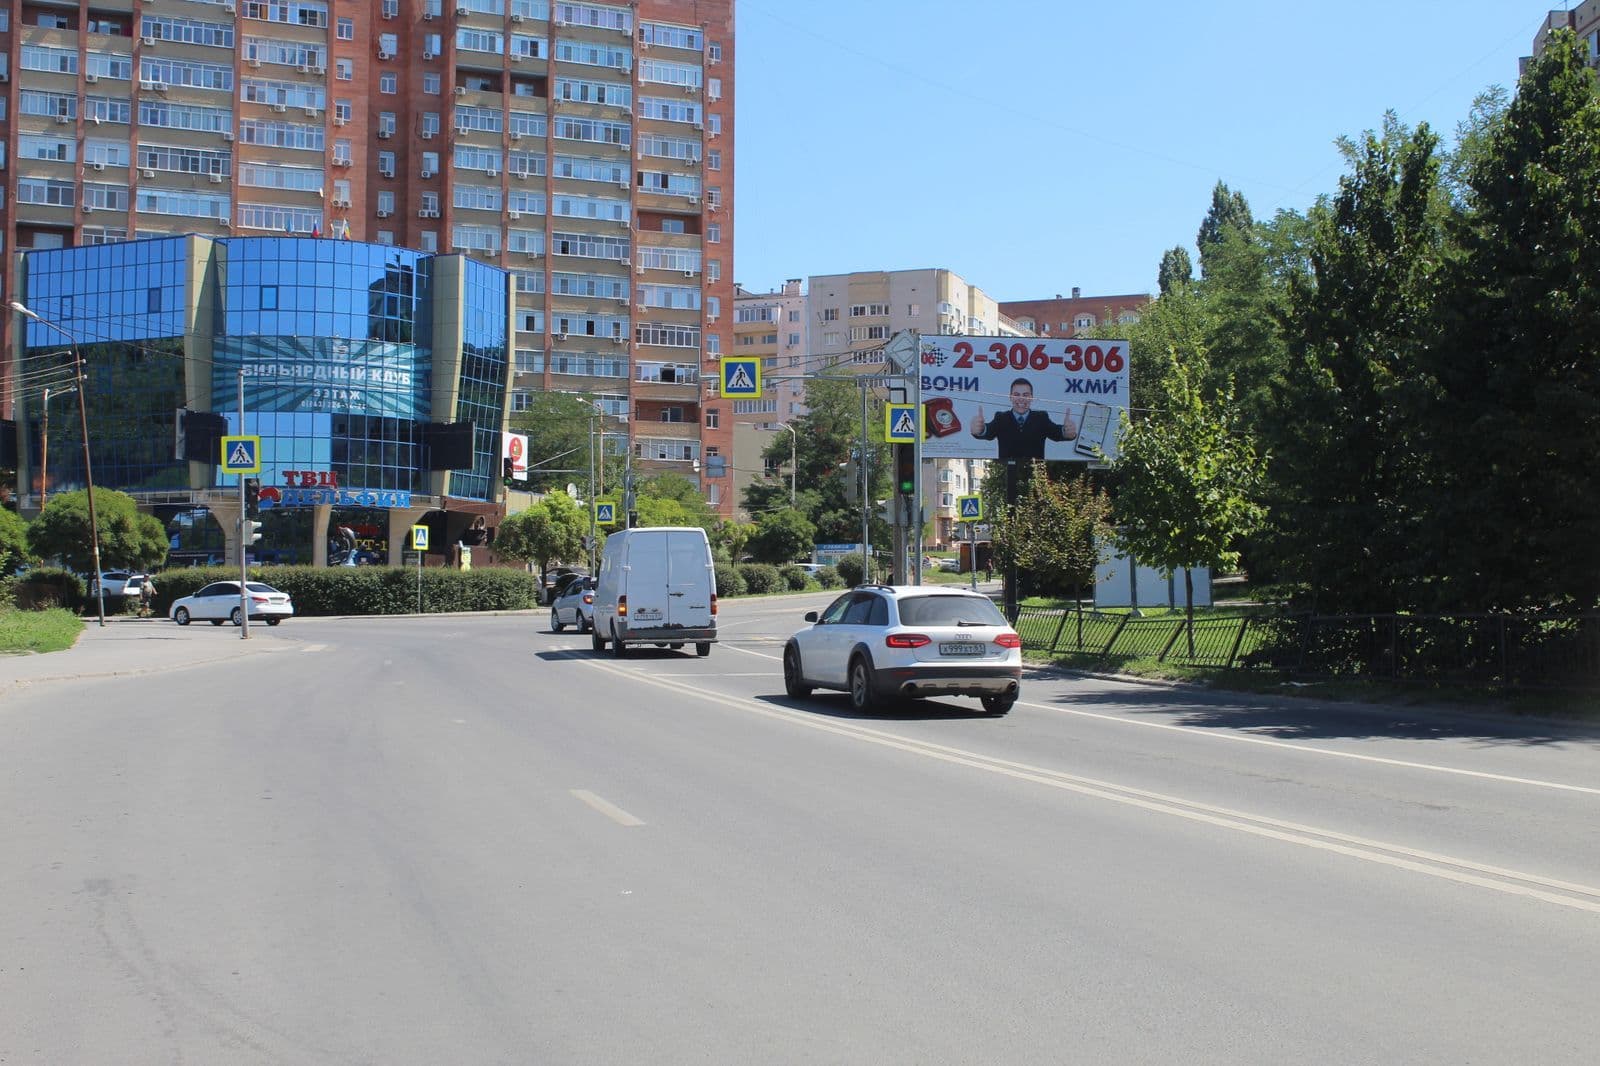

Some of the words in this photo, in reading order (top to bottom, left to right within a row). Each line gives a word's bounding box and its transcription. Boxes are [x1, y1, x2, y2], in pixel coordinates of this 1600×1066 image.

[952, 341, 1125, 373] 2-306-306
[242, 363, 367, 382] БИЛЬЯРДНЫЙ
[371, 369, 411, 386] КЛУБ
[921, 375, 980, 392] ВОНИ
[1065, 378, 1118, 395] ЖМИ
[282, 471, 338, 489] ТВЦ
[281, 488, 412, 508] ДЕЛЬФИН
